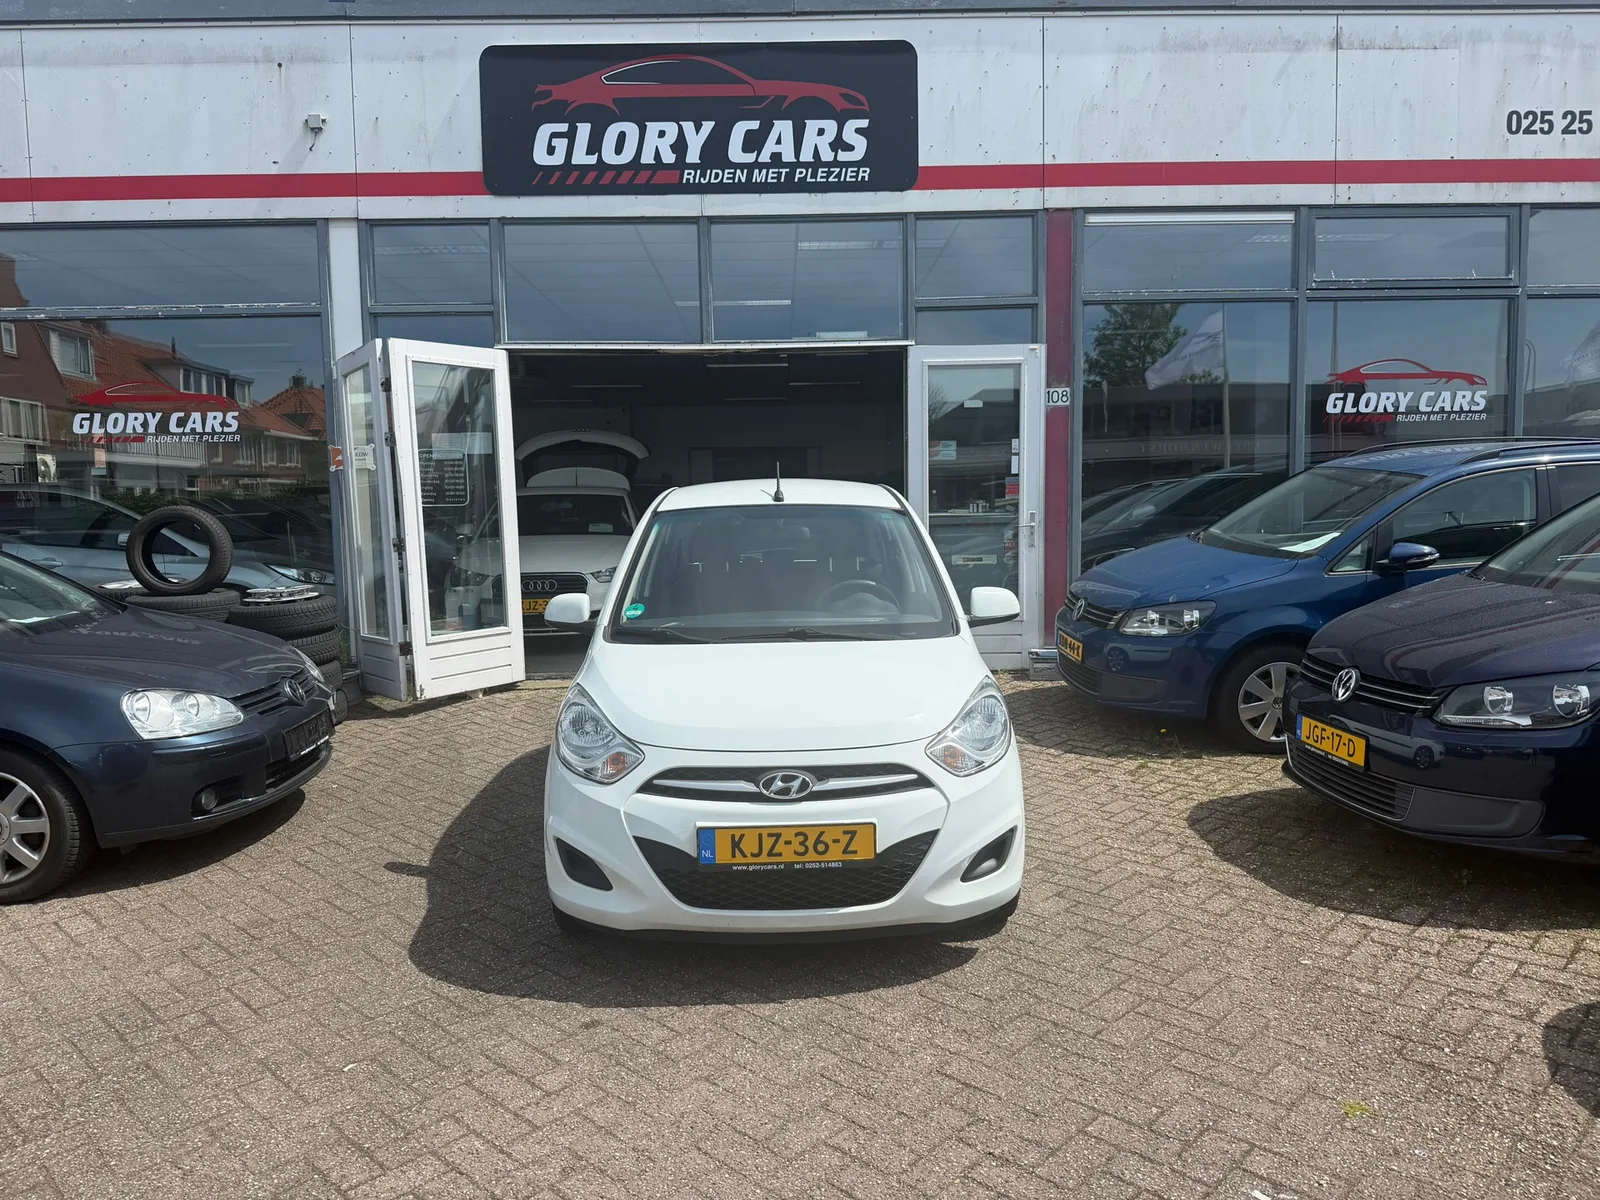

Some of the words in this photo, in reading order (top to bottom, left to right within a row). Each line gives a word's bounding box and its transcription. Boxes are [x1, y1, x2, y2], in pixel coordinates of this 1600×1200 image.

[1506, 110, 1554, 135] 025
[1561, 110, 1593, 135] 25
[532, 121, 716, 166] GLORY
[727, 118, 870, 164] CARS
[682, 168, 748, 185] RIJDEN
[752, 168, 792, 183] MET
[794, 167, 870, 183] PLEZIER
[1046, 389, 1069, 403] 108
[1325, 391, 1414, 414] GLORY
[1418, 390, 1488, 412] CARS
[72, 412, 163, 434] GLORY
[168, 411, 239, 433] CARS
[1396, 414, 1428, 422] RIJDEN
[1450, 413, 1487, 421] PLEZIER
[147, 435, 180, 443] RIJDEN
[181, 435, 200, 443] MET
[1305, 722, 1356, 758] JGF-17-D
[701, 849, 713, 858] NL
[730, 829, 858, 859] KJZ-36-Z
[732, 863, 785, 871] www.glorycars.nl
